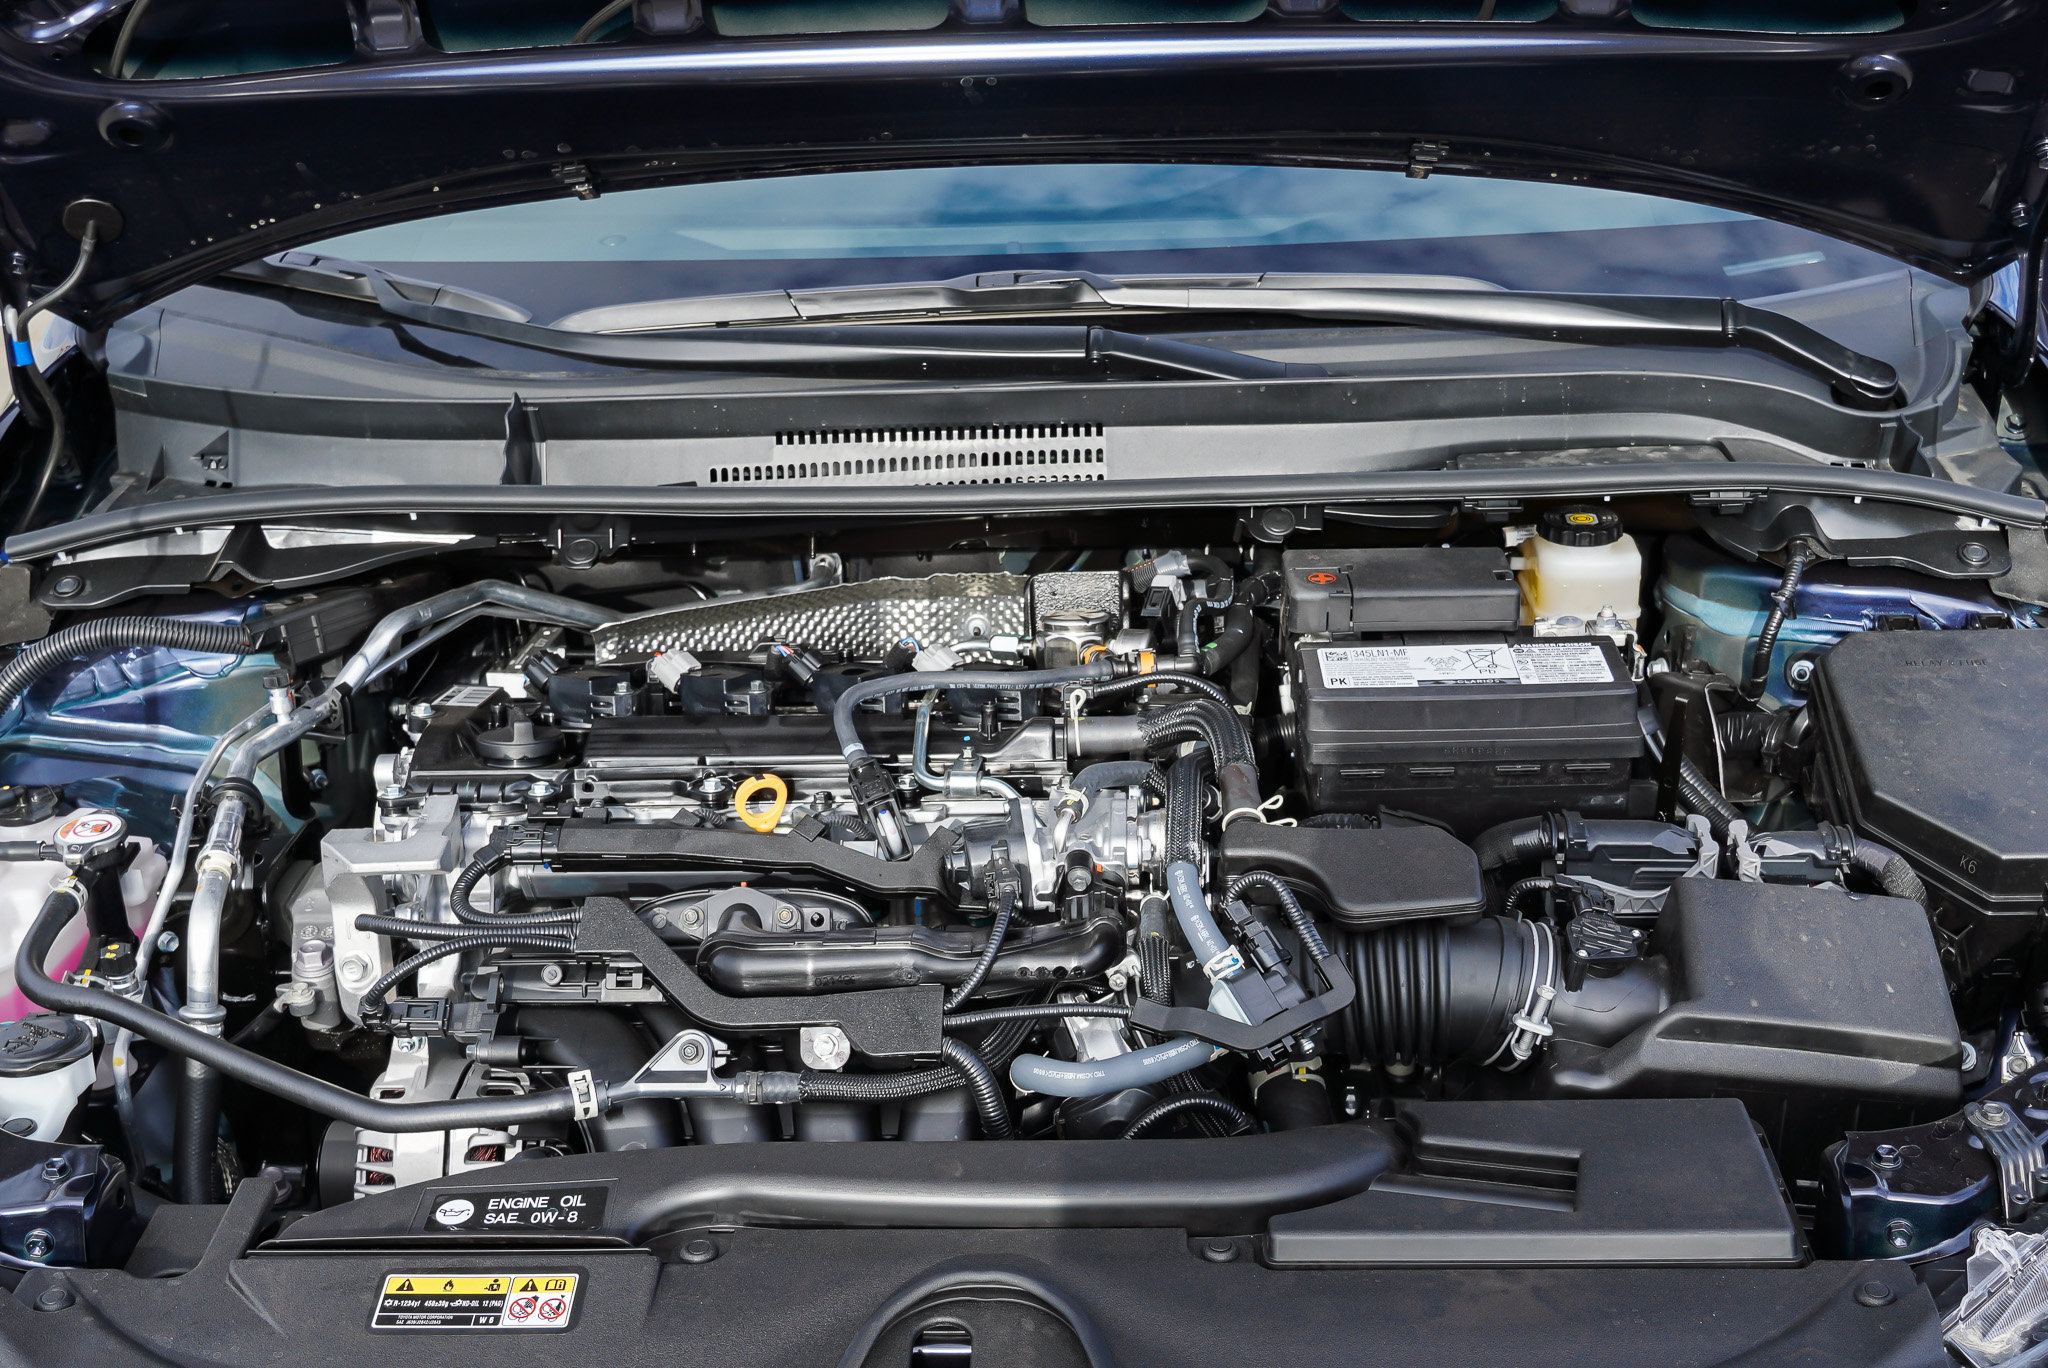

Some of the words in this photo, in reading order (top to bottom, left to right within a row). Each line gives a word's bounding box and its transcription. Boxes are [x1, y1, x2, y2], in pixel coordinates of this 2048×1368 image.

[1330, 677, 1348, 686] PK
[1960, 855, 1977, 874] K6
[487, 1196, 550, 1210] ENGINE
[560, 1194, 587, 1208] OIL
[483, 1212, 519, 1224] SAE
[530, 1211, 579, 1223] 0W-8
[479, 1316, 487, 1324] W
[488, 1316, 494, 1324] 6
